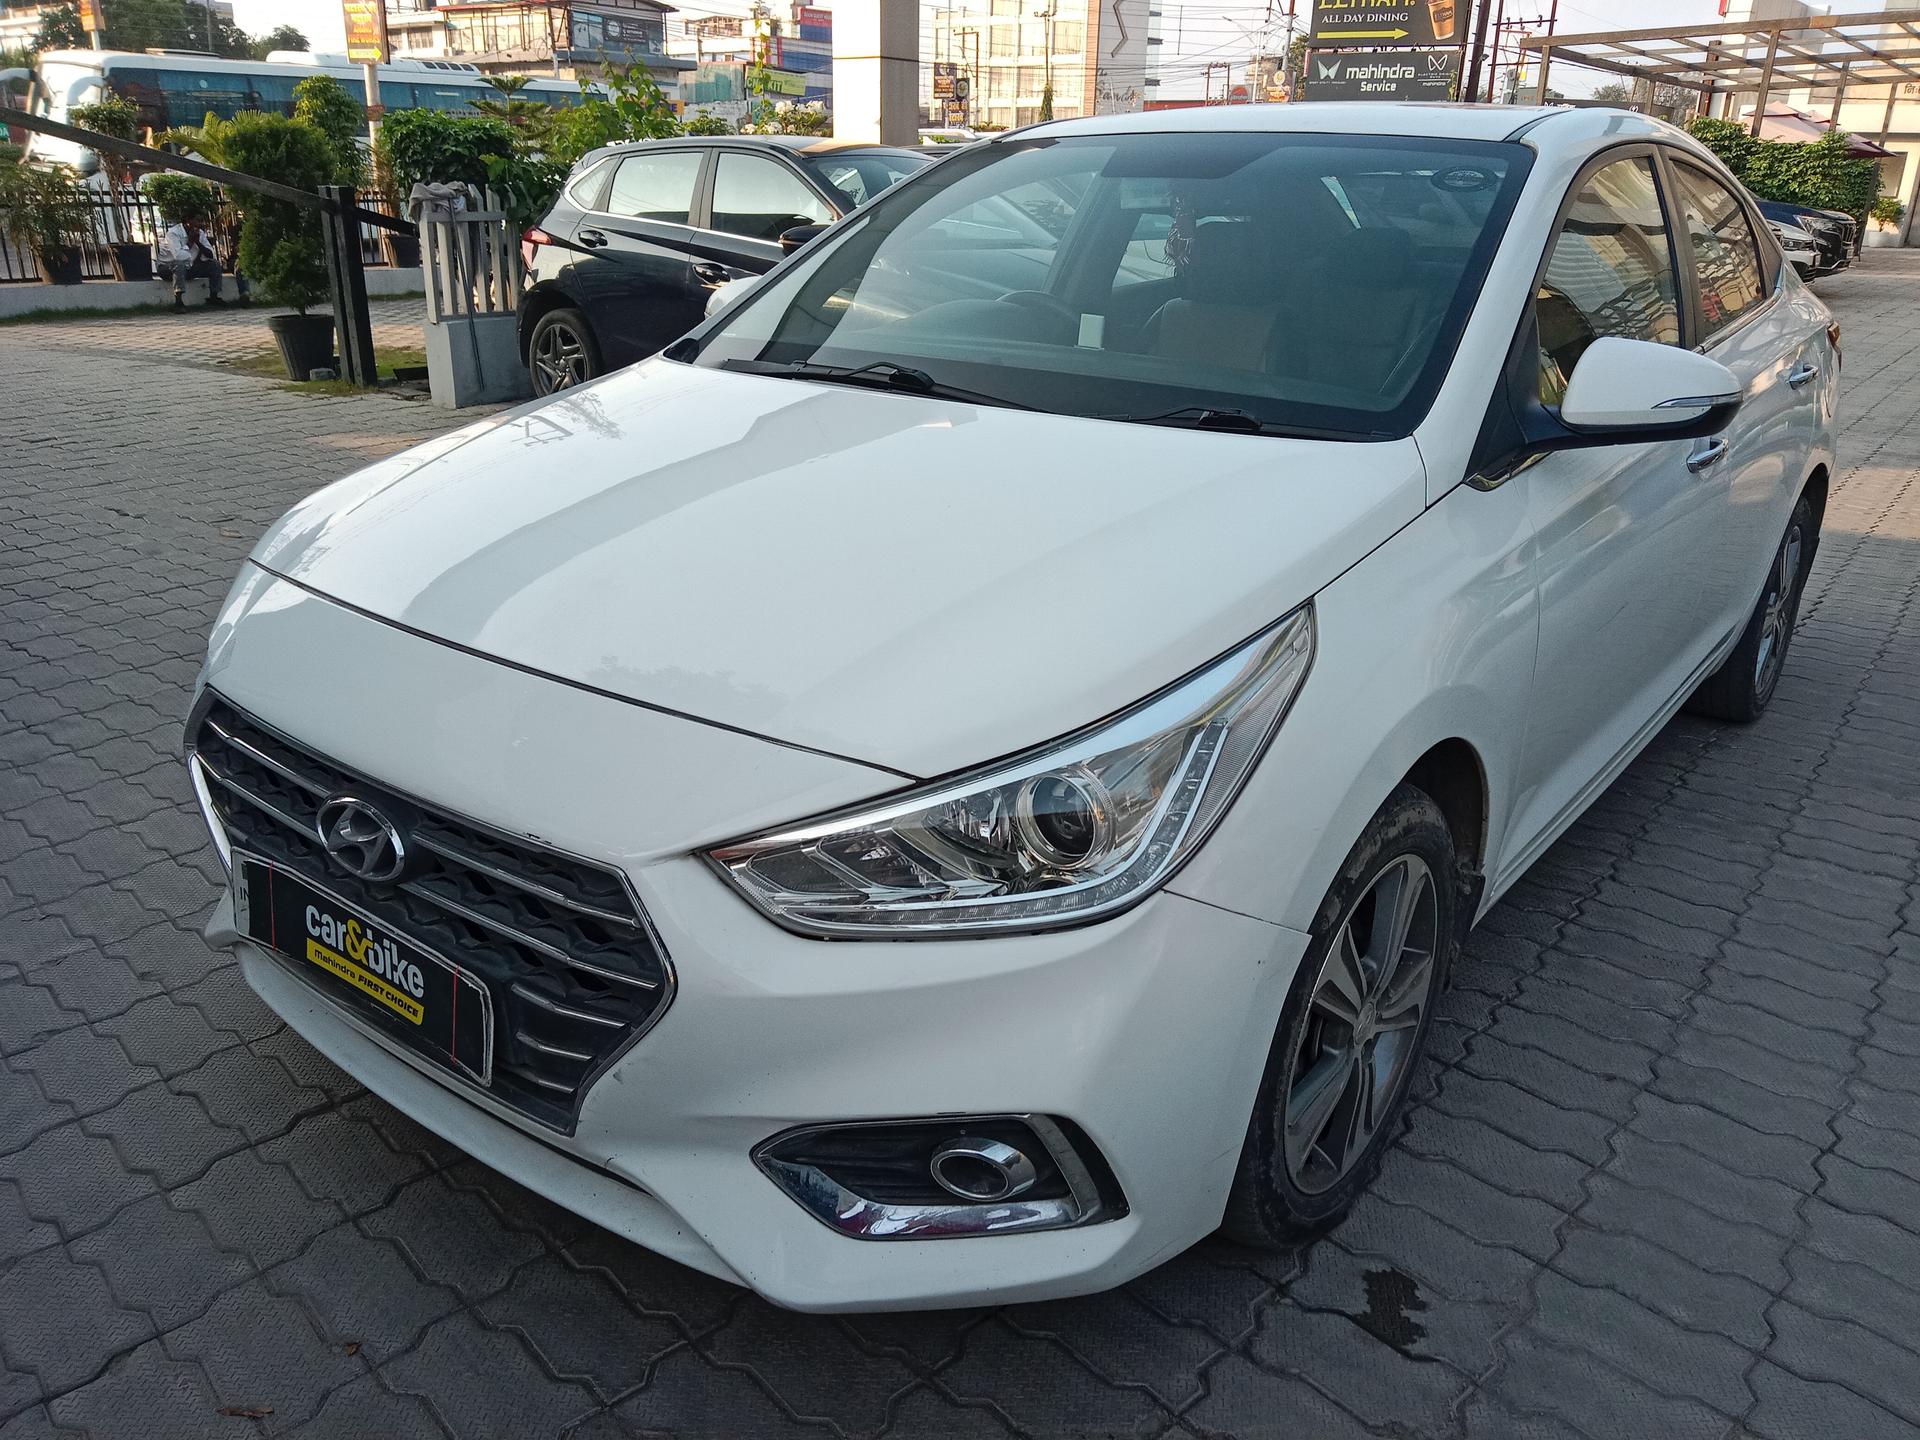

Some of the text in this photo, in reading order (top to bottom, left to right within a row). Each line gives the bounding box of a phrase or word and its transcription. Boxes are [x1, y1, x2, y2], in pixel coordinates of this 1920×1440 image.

[1321, 12, 1409, 24] ALL DAY DINING
[1346, 63, 1416, 80] mahindra
[1360, 80, 1397, 92] Service
[305, 904, 425, 999] car&bike
[314, 948, 420, 1019] mahindra FIRST CHOICE
